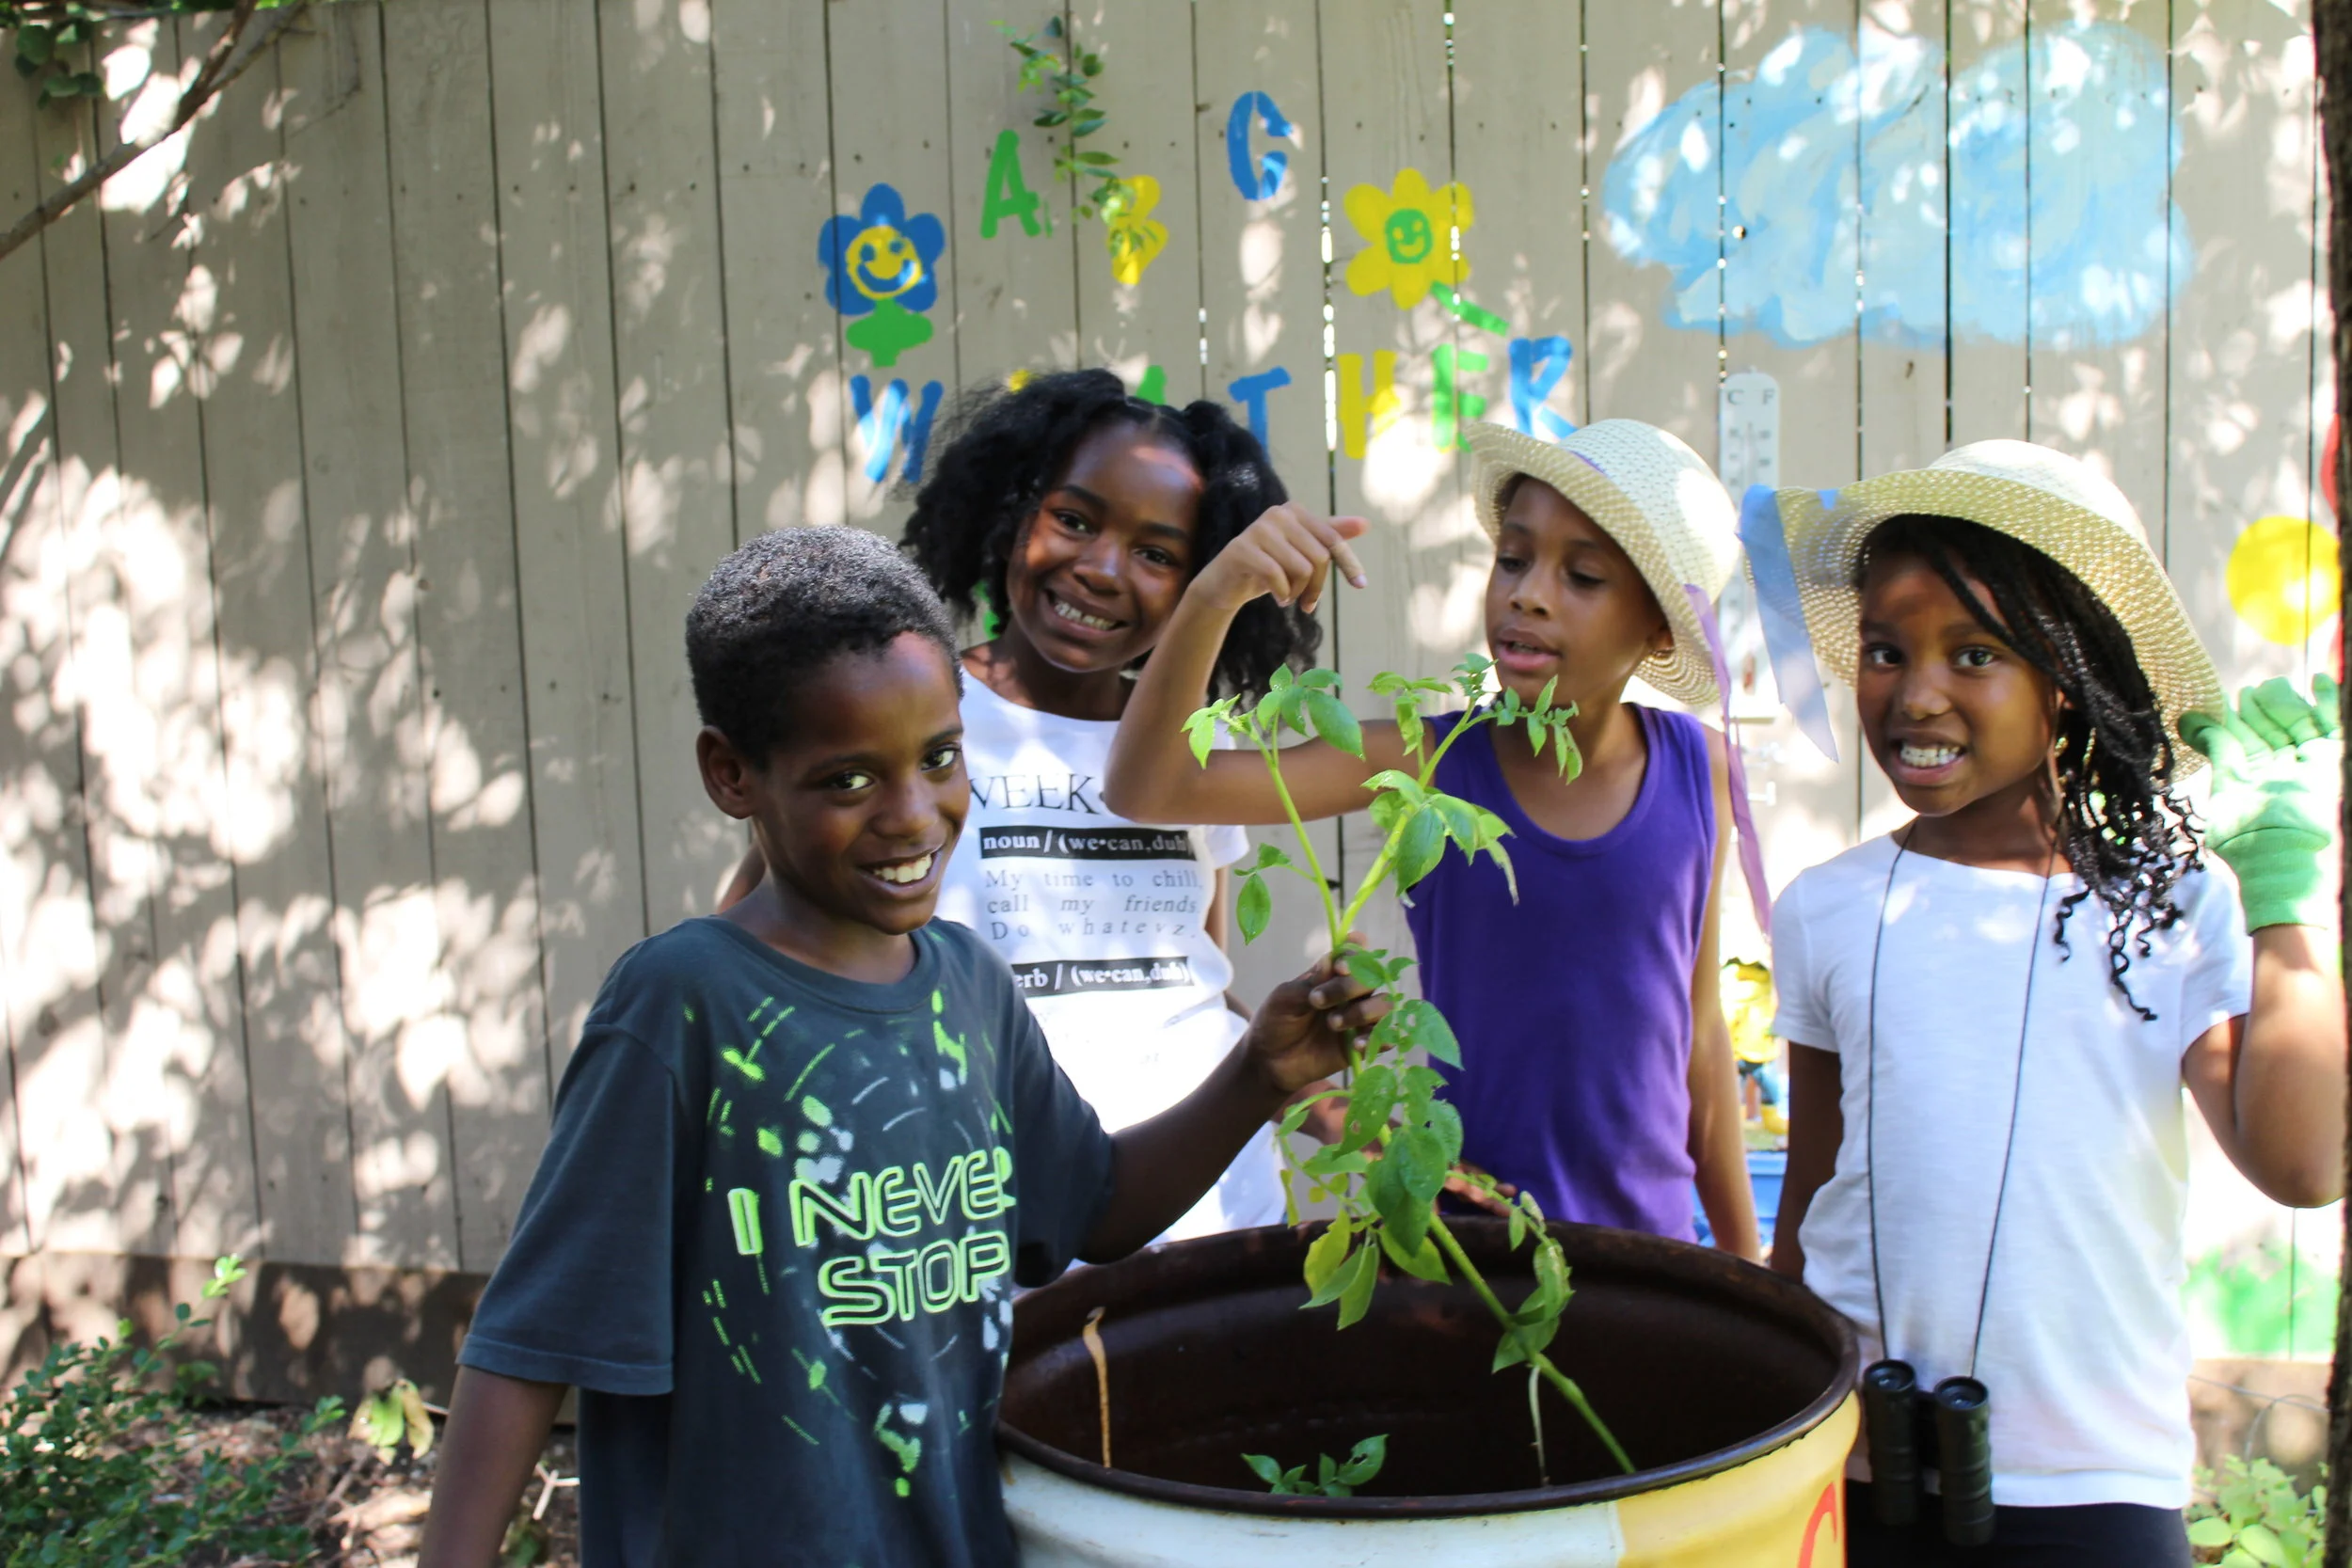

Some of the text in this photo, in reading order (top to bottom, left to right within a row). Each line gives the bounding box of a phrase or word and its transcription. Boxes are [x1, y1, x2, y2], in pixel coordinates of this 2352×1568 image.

[1727, 388, 1775, 405] C F
[850, 336, 1577, 485] WTHER
[985, 869, 1023, 891] My
[1044, 873, 1093, 887] time
[1112, 873, 1135, 888] to
[987, 895, 1029, 914] call
[1060, 898, 1094, 915] my
[991, 921, 1029, 941] Do
[1013, 968, 1049, 988] erb
[727, 1187, 763, 1256] I
[818, 1230, 1011, 1327] STOP
